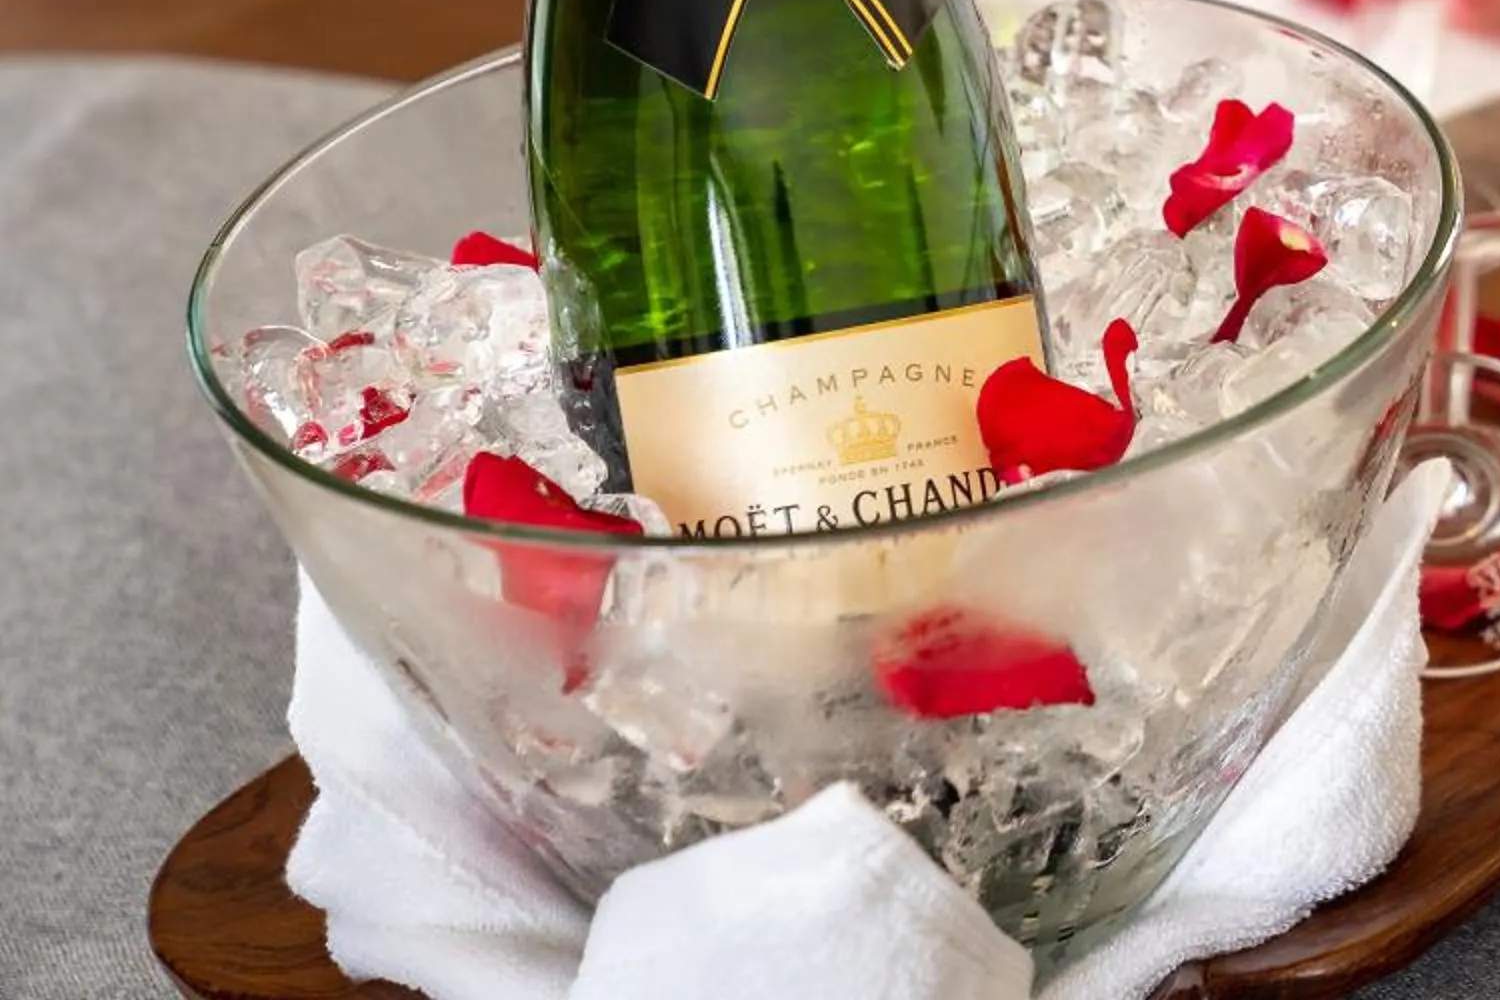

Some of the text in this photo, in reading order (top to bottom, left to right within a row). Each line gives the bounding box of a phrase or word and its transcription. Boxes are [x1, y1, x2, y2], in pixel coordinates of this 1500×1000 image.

[728, 363, 977, 430] CHAMPAGNE
[906, 434, 959, 452] FRANCE
[816, 504, 839, 533] &
[852, 467, 1001, 529] CHAND
